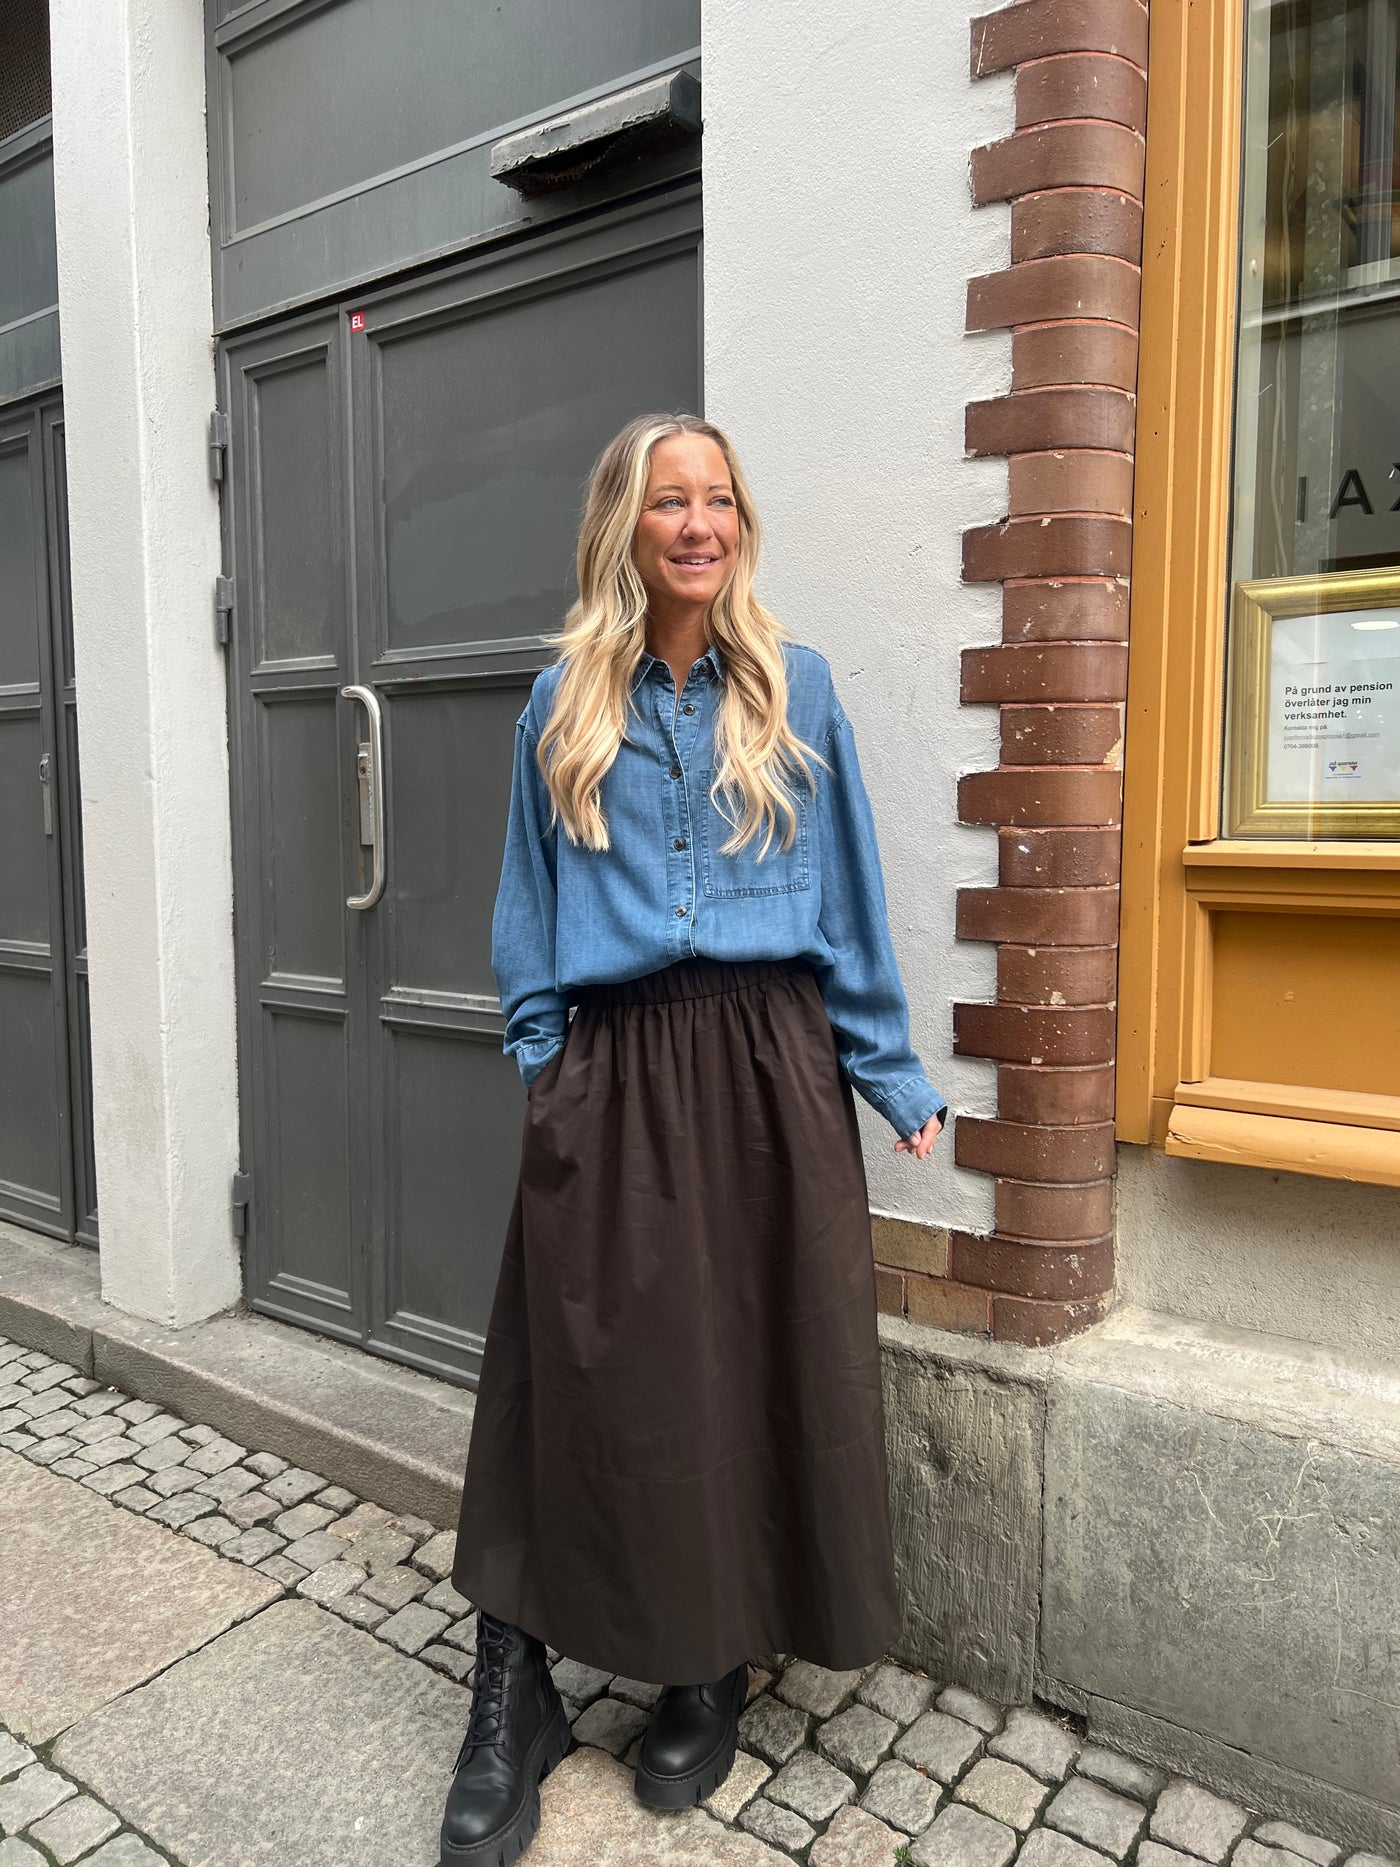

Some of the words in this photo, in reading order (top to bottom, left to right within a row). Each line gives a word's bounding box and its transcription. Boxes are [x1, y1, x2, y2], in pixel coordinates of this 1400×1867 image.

[352, 315, 363, 328] EL
[1297, 463, 1400, 522] IA
[1285, 686, 1298, 695] På
[1301, 685, 1332, 696] grund
[1334, 685, 1347, 693] av
[1349, 682, 1393, 693] pension
[1284, 698, 1330, 707] överlåter
[1332, 697, 1349, 707] jag
[1351, 696, 1372, 704] min
[1284, 710, 1347, 720] verksamhet.
